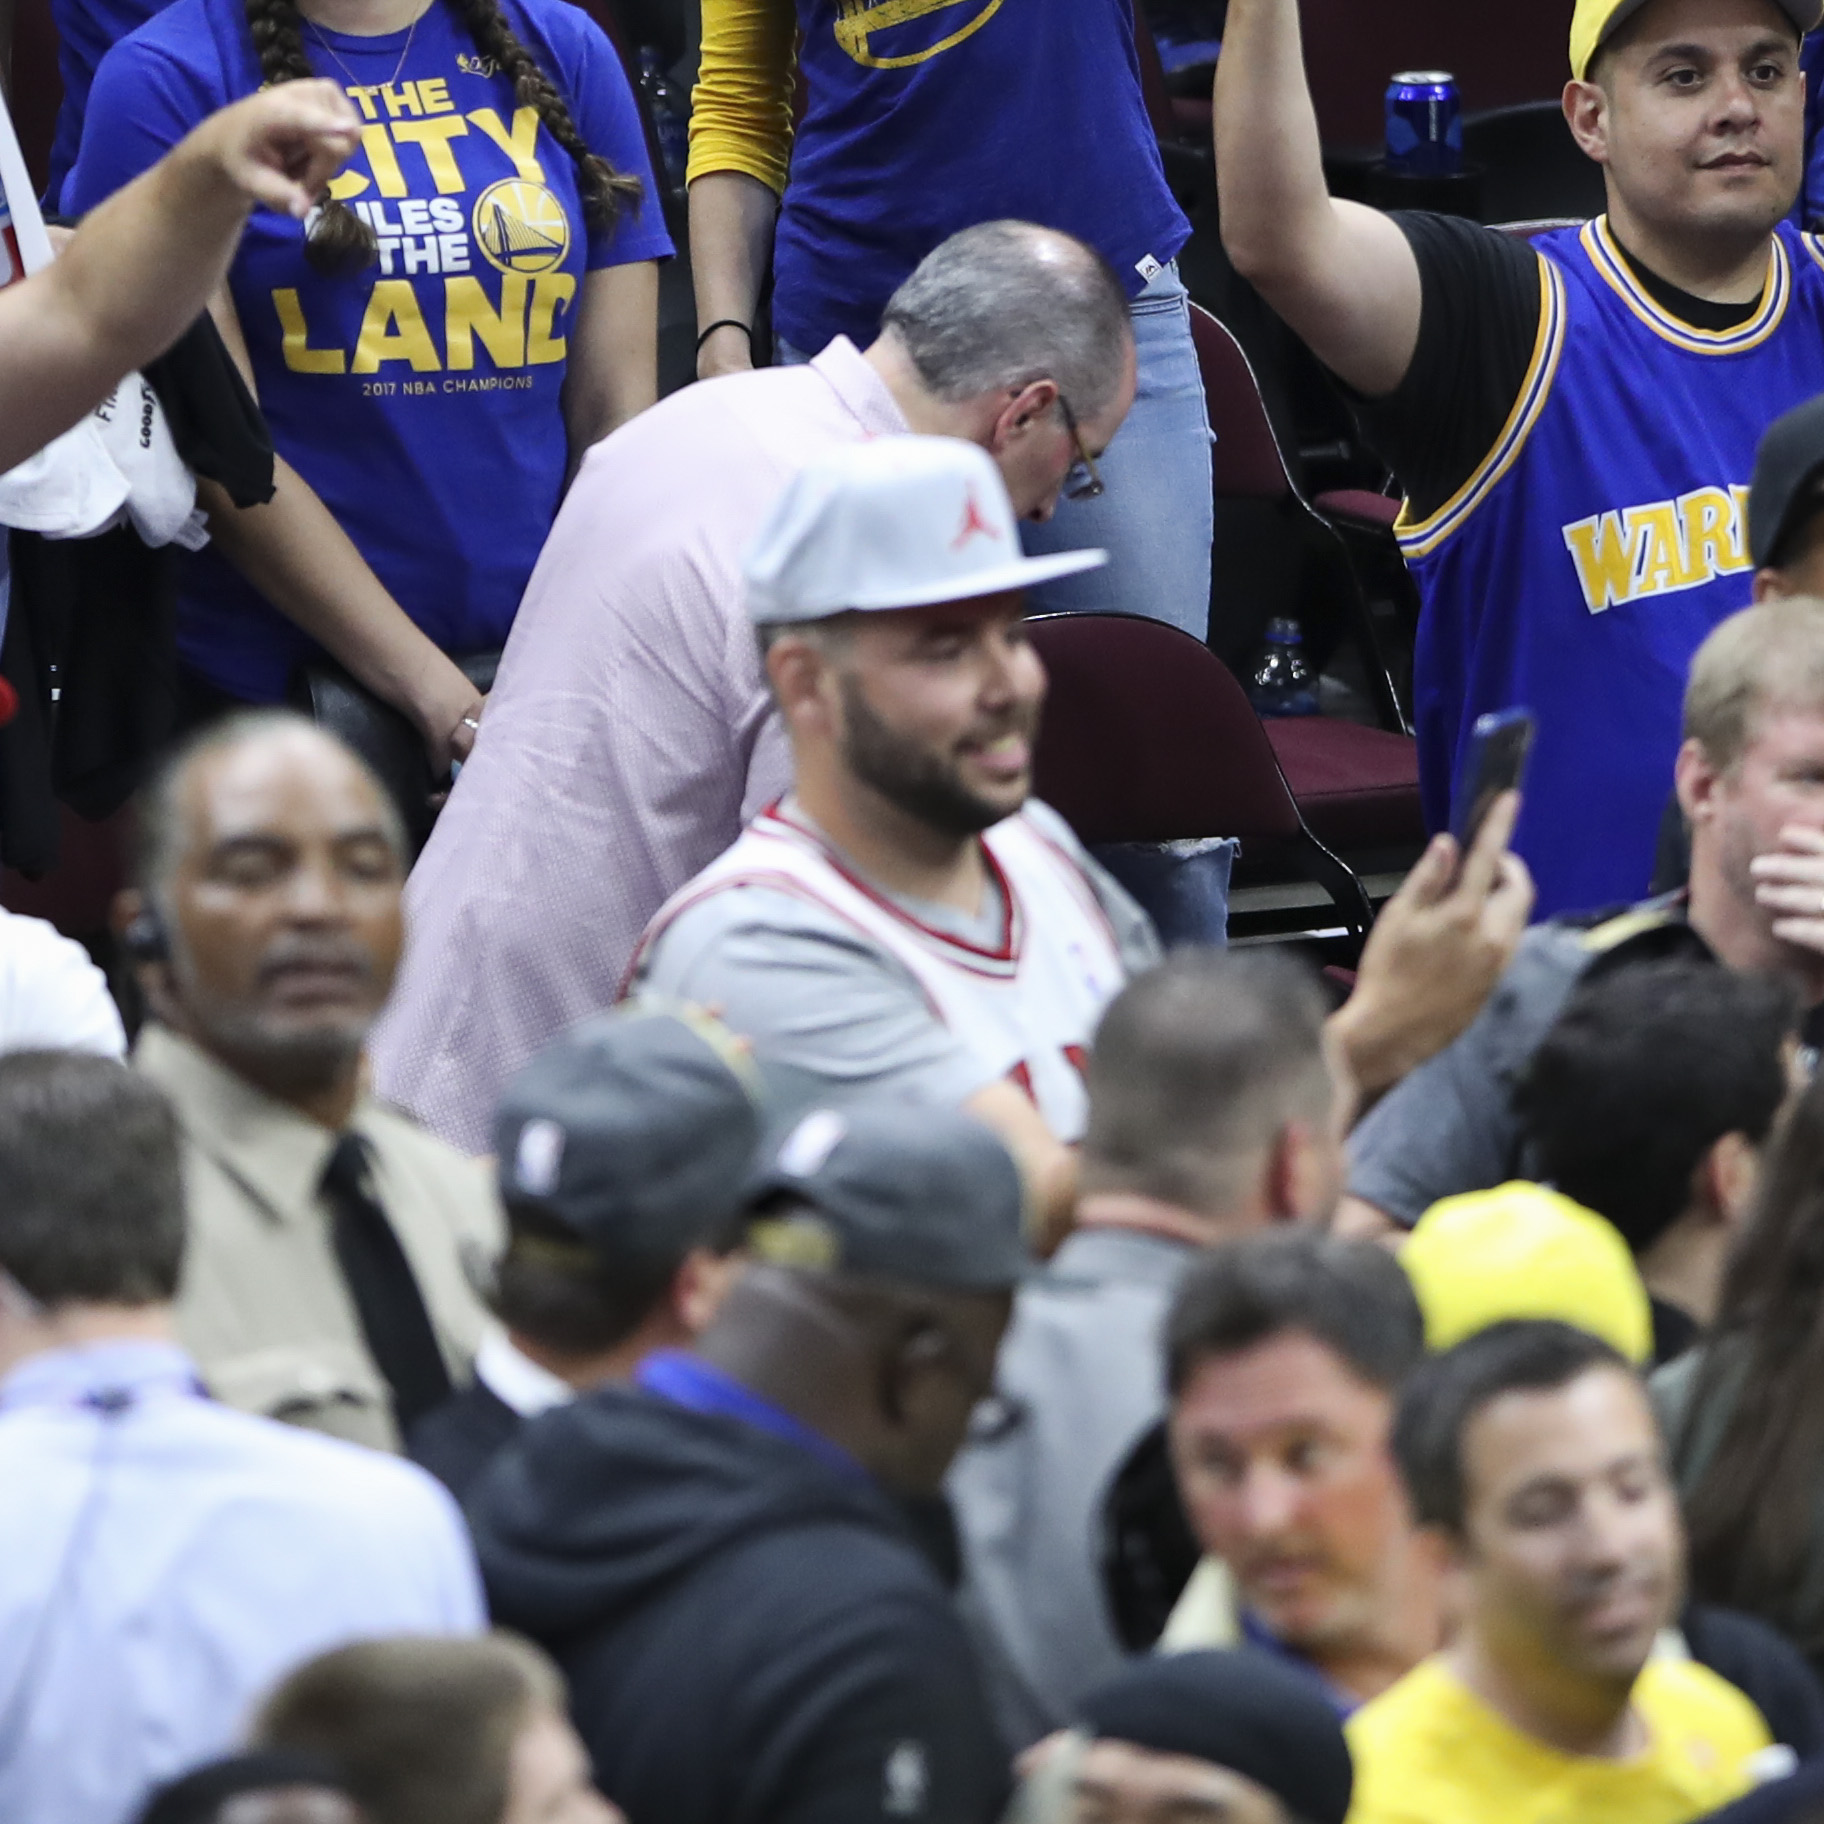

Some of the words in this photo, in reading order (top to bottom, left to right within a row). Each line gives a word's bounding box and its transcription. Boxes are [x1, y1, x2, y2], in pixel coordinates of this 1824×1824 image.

[347, 78, 455, 119] THE
[304, 197, 465, 242] LES
[374, 233, 471, 275] THE
[271, 272, 576, 374] LAND
[363, 381, 396, 397] 2017
[403, 377, 436, 396] NBA
[443, 375, 534, 394] CHAMPIONS
[140, 382, 157, 449] GOODY
